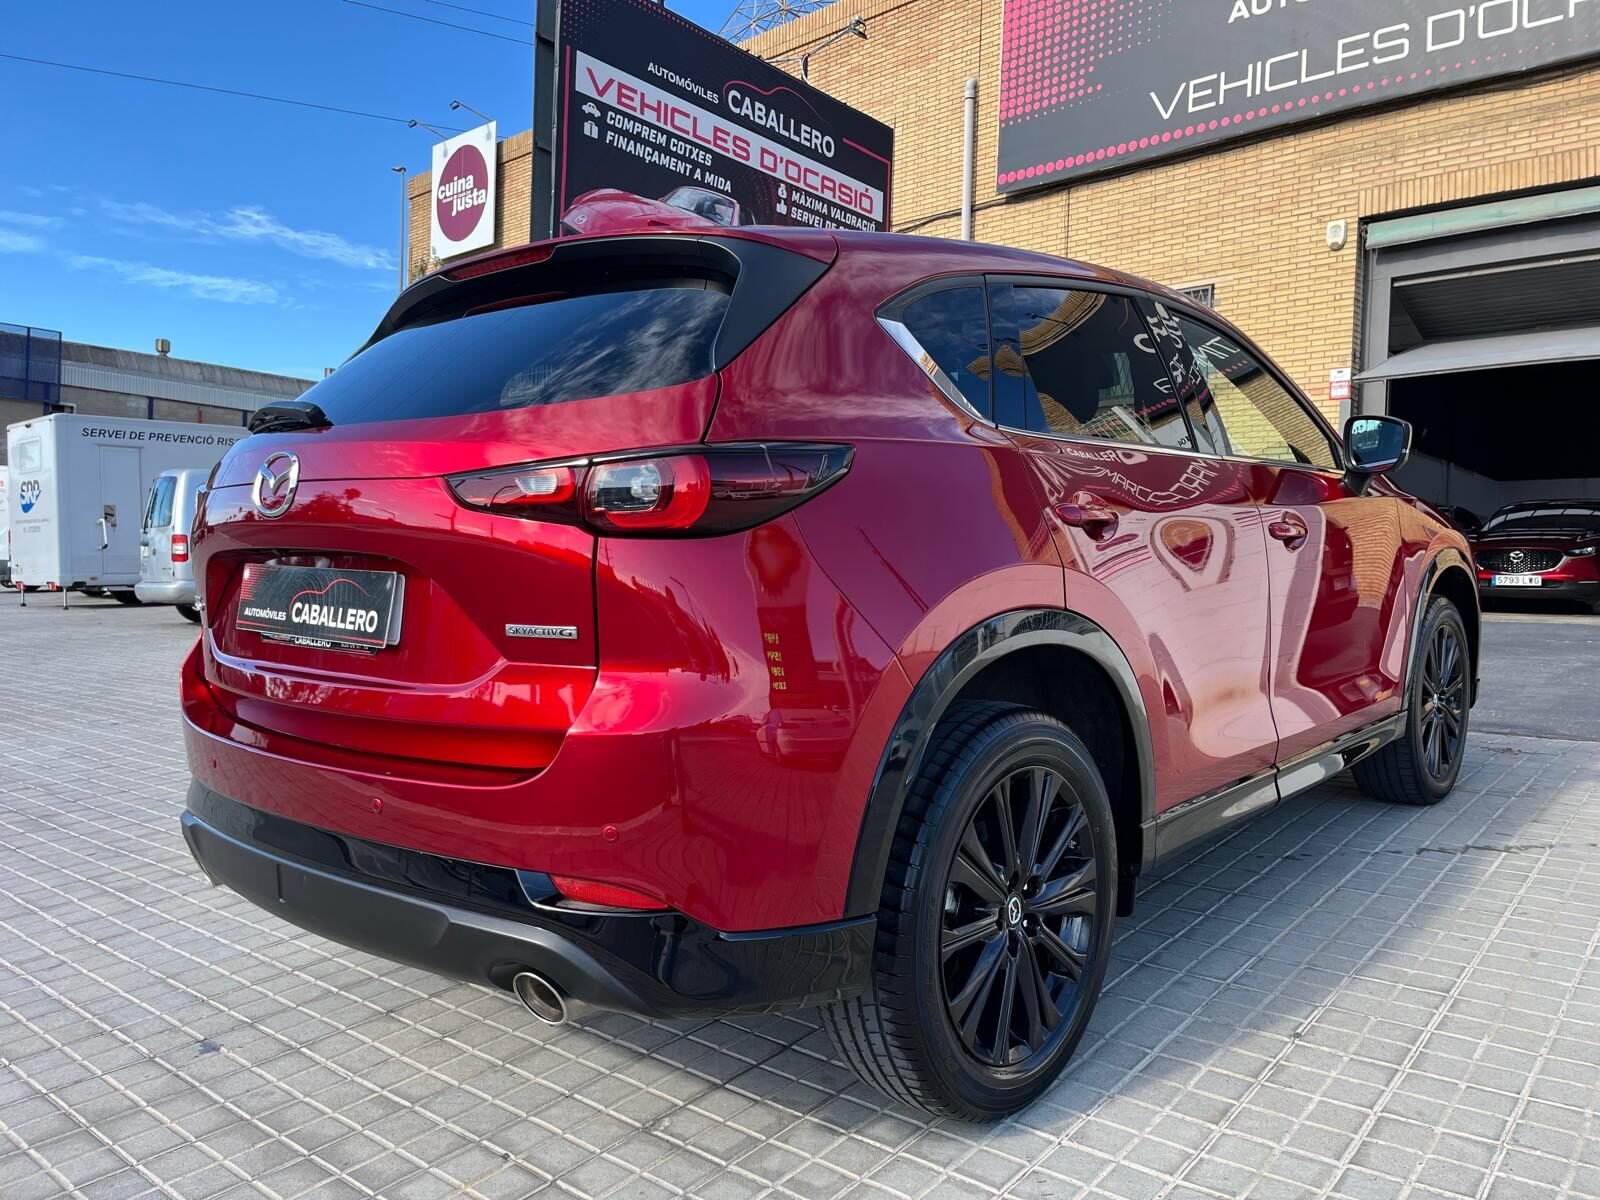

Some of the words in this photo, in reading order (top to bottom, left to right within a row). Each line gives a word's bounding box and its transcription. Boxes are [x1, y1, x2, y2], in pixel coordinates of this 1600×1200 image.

[1150, 23, 1410, 120] VEHICLES
[647, 62, 720, 104] AUTOMÓVILES
[727, 89, 836, 158] CABALLERO
[586, 66, 751, 162] VEHICLES
[760, 145, 875, 216] D'OCASIÓ
[606, 111, 668, 147] COMPREM
[669, 137, 713, 167] COTXES
[605, 130, 693, 177] FINANÇAMENT
[693, 167, 702, 181] A
[704, 171, 732, 193] MIDA
[438, 174, 474, 200] cuina
[451, 187, 487, 217] justa
[81, 427, 127, 440] SERVEI
[129, 431, 146, 441] DE
[148, 431, 215, 446] PREVENCIÓ
[1497, 576, 1520, 585] 5793
[243, 607, 287, 621] AUTOMÓVILES
[291, 601, 379, 633] CABALLERO
